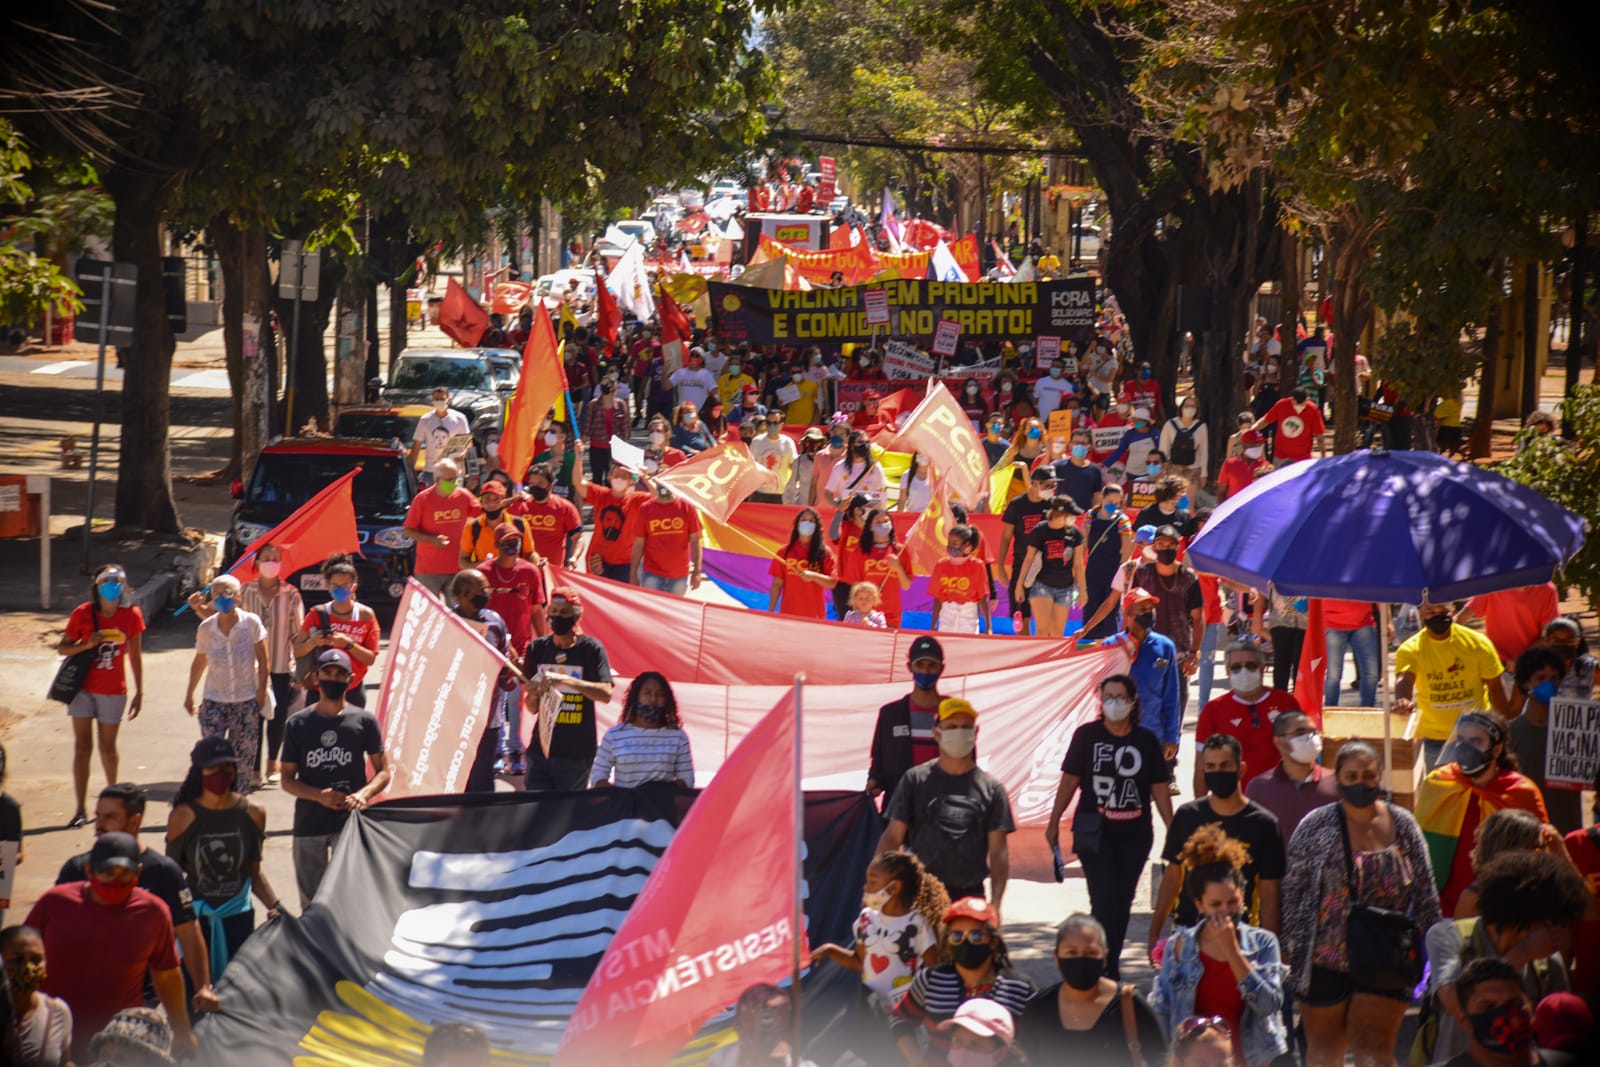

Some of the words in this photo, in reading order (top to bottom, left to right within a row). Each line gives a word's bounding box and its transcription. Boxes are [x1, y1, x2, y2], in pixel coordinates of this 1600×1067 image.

[777, 228, 809, 240] CTB
[928, 281, 1039, 305] PROPINA
[1051, 291, 1091, 307] FORA
[773, 313, 789, 338] E
[901, 310, 933, 336] NO
[1096, 439, 1120, 448] CRIM
[434, 509, 461, 521] PCO
[650, 516, 684, 531] PCO
